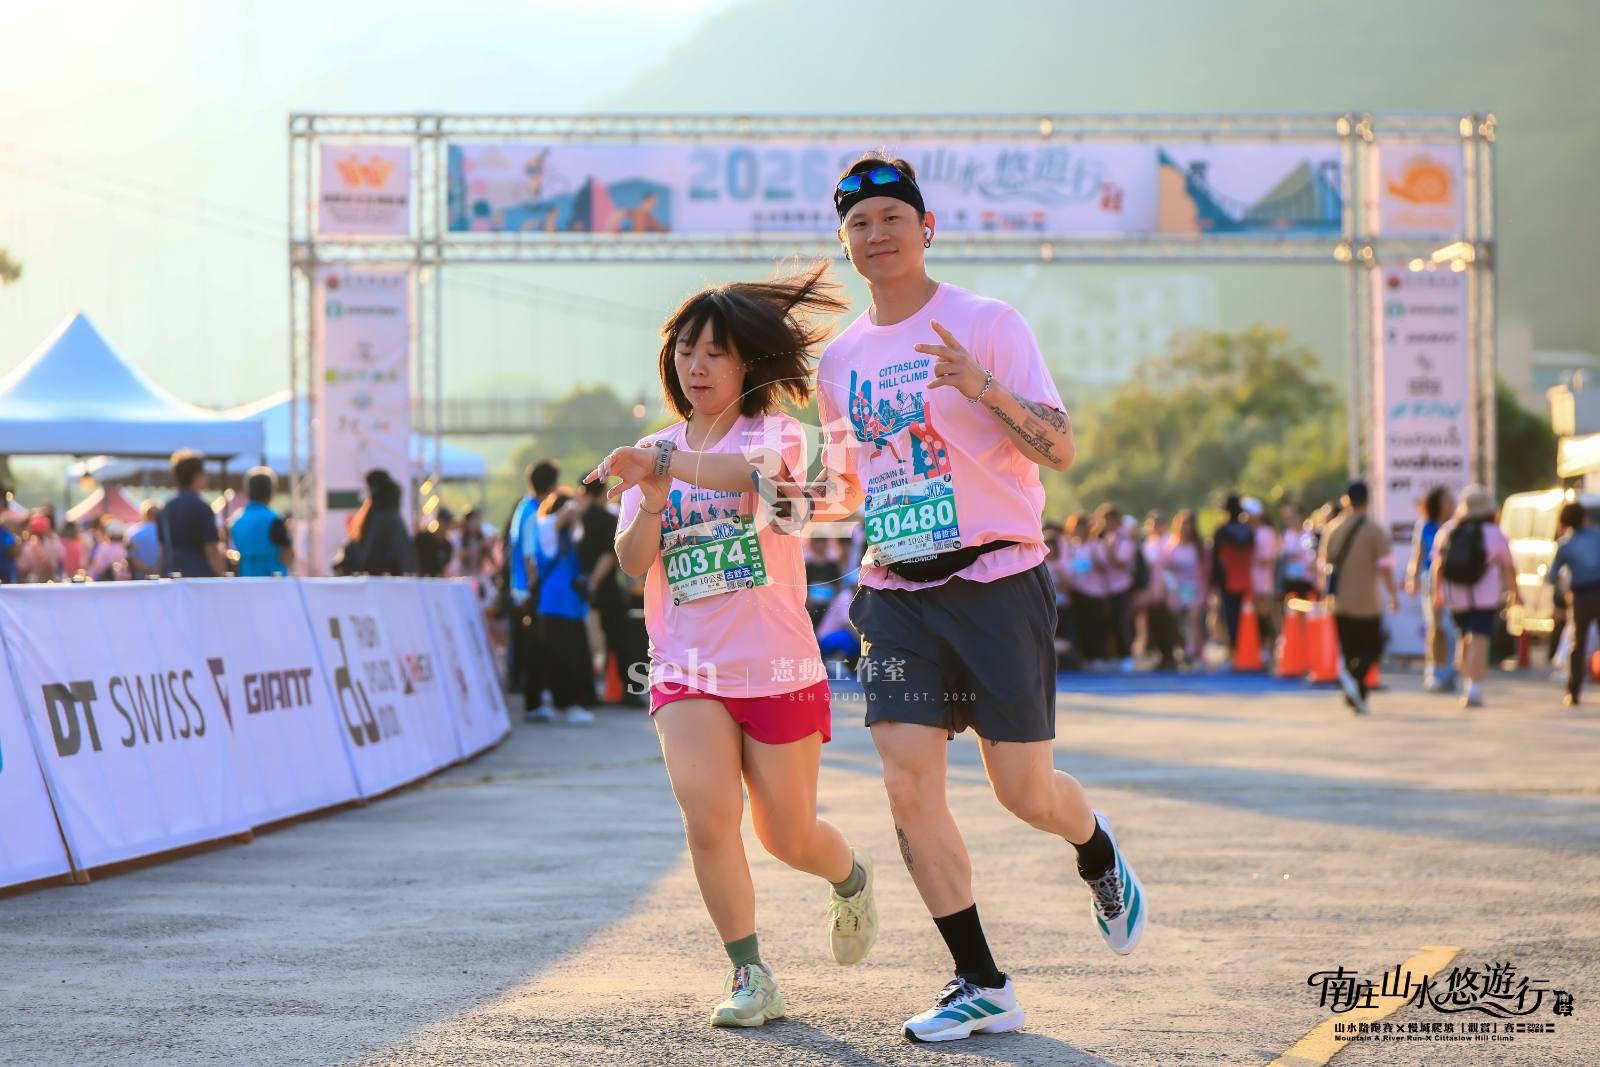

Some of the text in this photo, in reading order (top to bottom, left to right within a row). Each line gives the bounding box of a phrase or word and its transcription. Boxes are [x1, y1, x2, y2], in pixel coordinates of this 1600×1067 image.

[689, 148, 828, 200] 2026
[879, 359, 930, 378] CITTASLOW
[879, 370, 928, 390] HILL CLIMB
[690, 492, 712, 502] HILL
[867, 477, 909, 493] RIVER RUN
[868, 500, 953, 542] 30480
[667, 541, 746, 579] 40374
[244, 666, 314, 715] GIANT
[42, 669, 206, 757] DT SWISS
